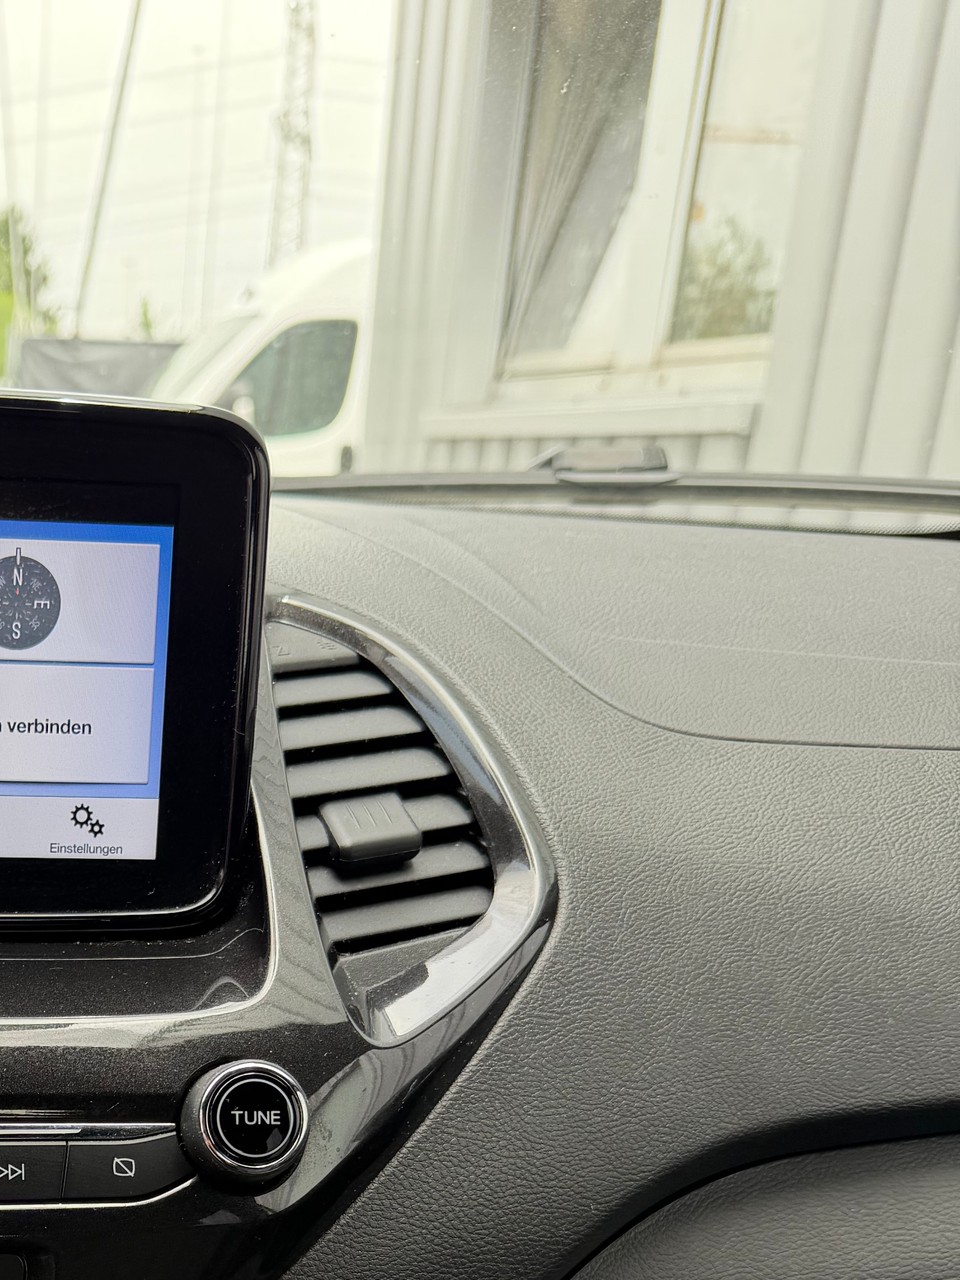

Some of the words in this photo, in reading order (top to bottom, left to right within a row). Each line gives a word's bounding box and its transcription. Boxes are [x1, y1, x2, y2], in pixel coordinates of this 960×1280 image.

[13, 567, 23, 586] N
[7, 717, 93, 736] verbinden
[49, 843, 124, 857] Einstellungen
[230, 1110, 281, 1125] TUNE
